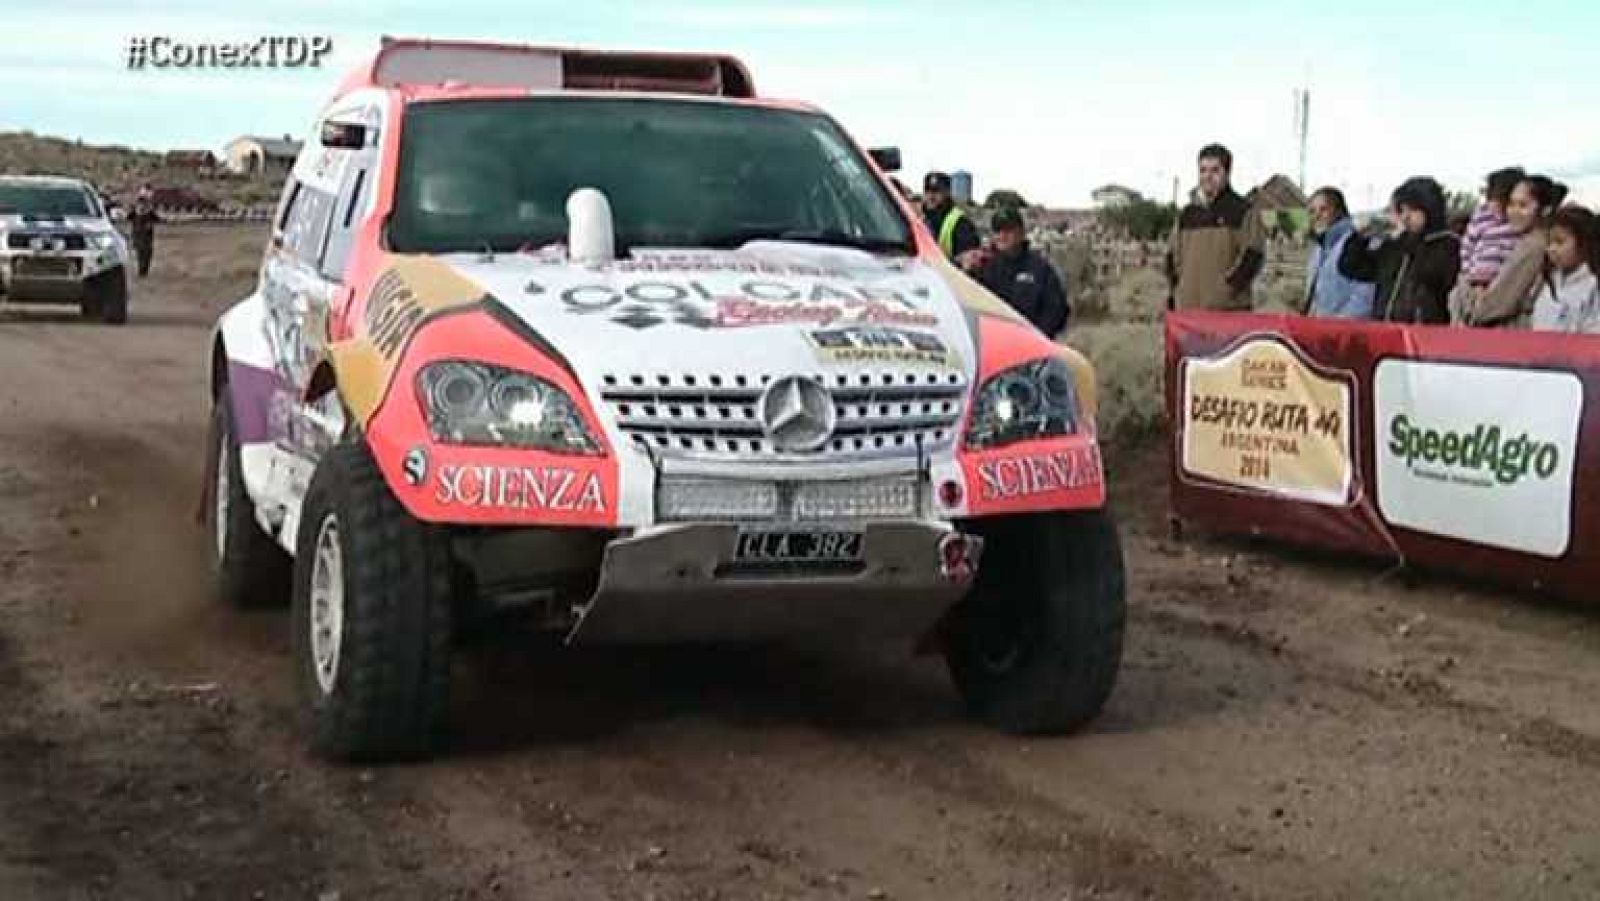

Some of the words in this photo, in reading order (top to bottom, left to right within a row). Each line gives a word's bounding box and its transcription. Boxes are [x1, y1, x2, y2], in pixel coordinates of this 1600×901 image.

[1191, 395, 1257, 428] DESAFIO
[1261, 401, 1308, 434] RUTA
[1314, 407, 1341, 438] 40
[1221, 431, 1301, 455] ARGENTINA
[1388, 414, 1558, 483] SpeedAgro
[435, 465, 607, 512] SCIENZA
